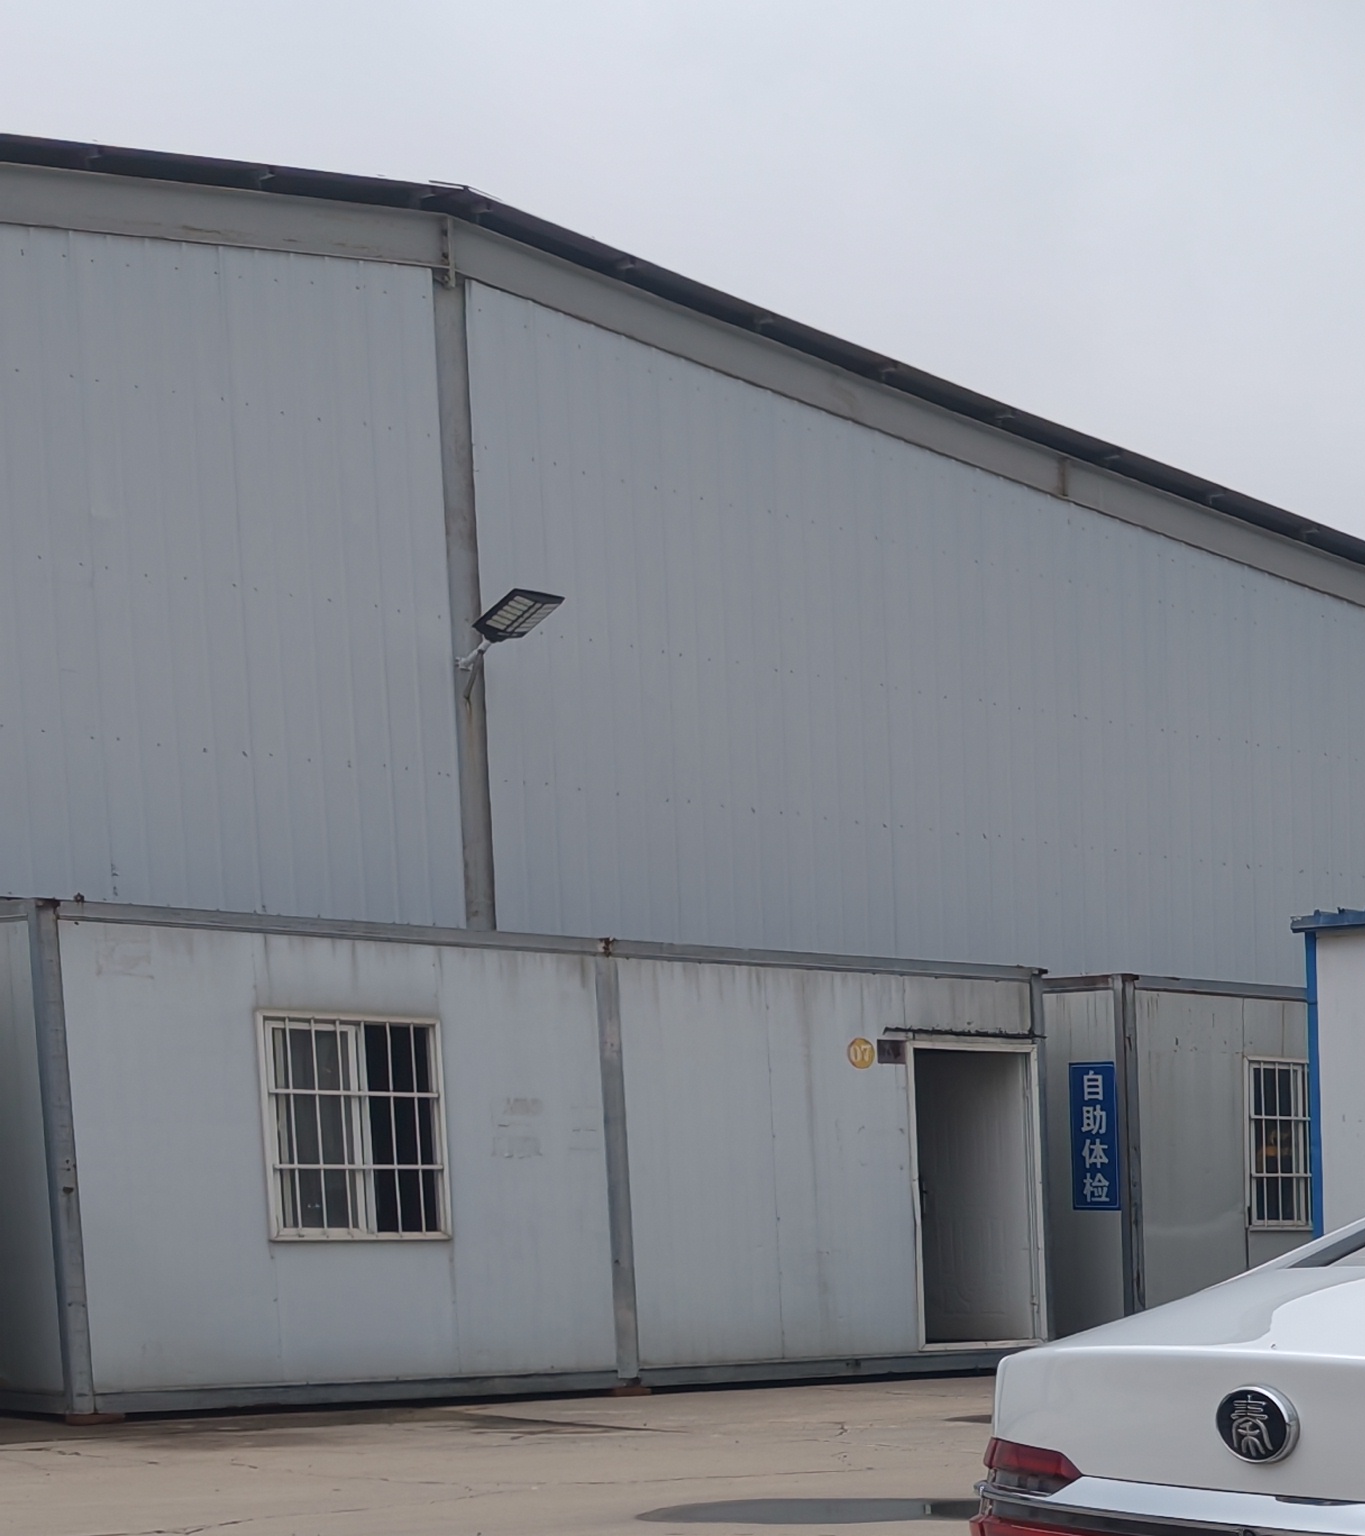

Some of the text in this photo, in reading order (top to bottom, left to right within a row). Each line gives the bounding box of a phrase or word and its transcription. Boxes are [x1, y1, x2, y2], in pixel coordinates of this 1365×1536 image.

[850, 1044, 872, 1062] 07
[1081, 1069, 1110, 1203] 自助体检
